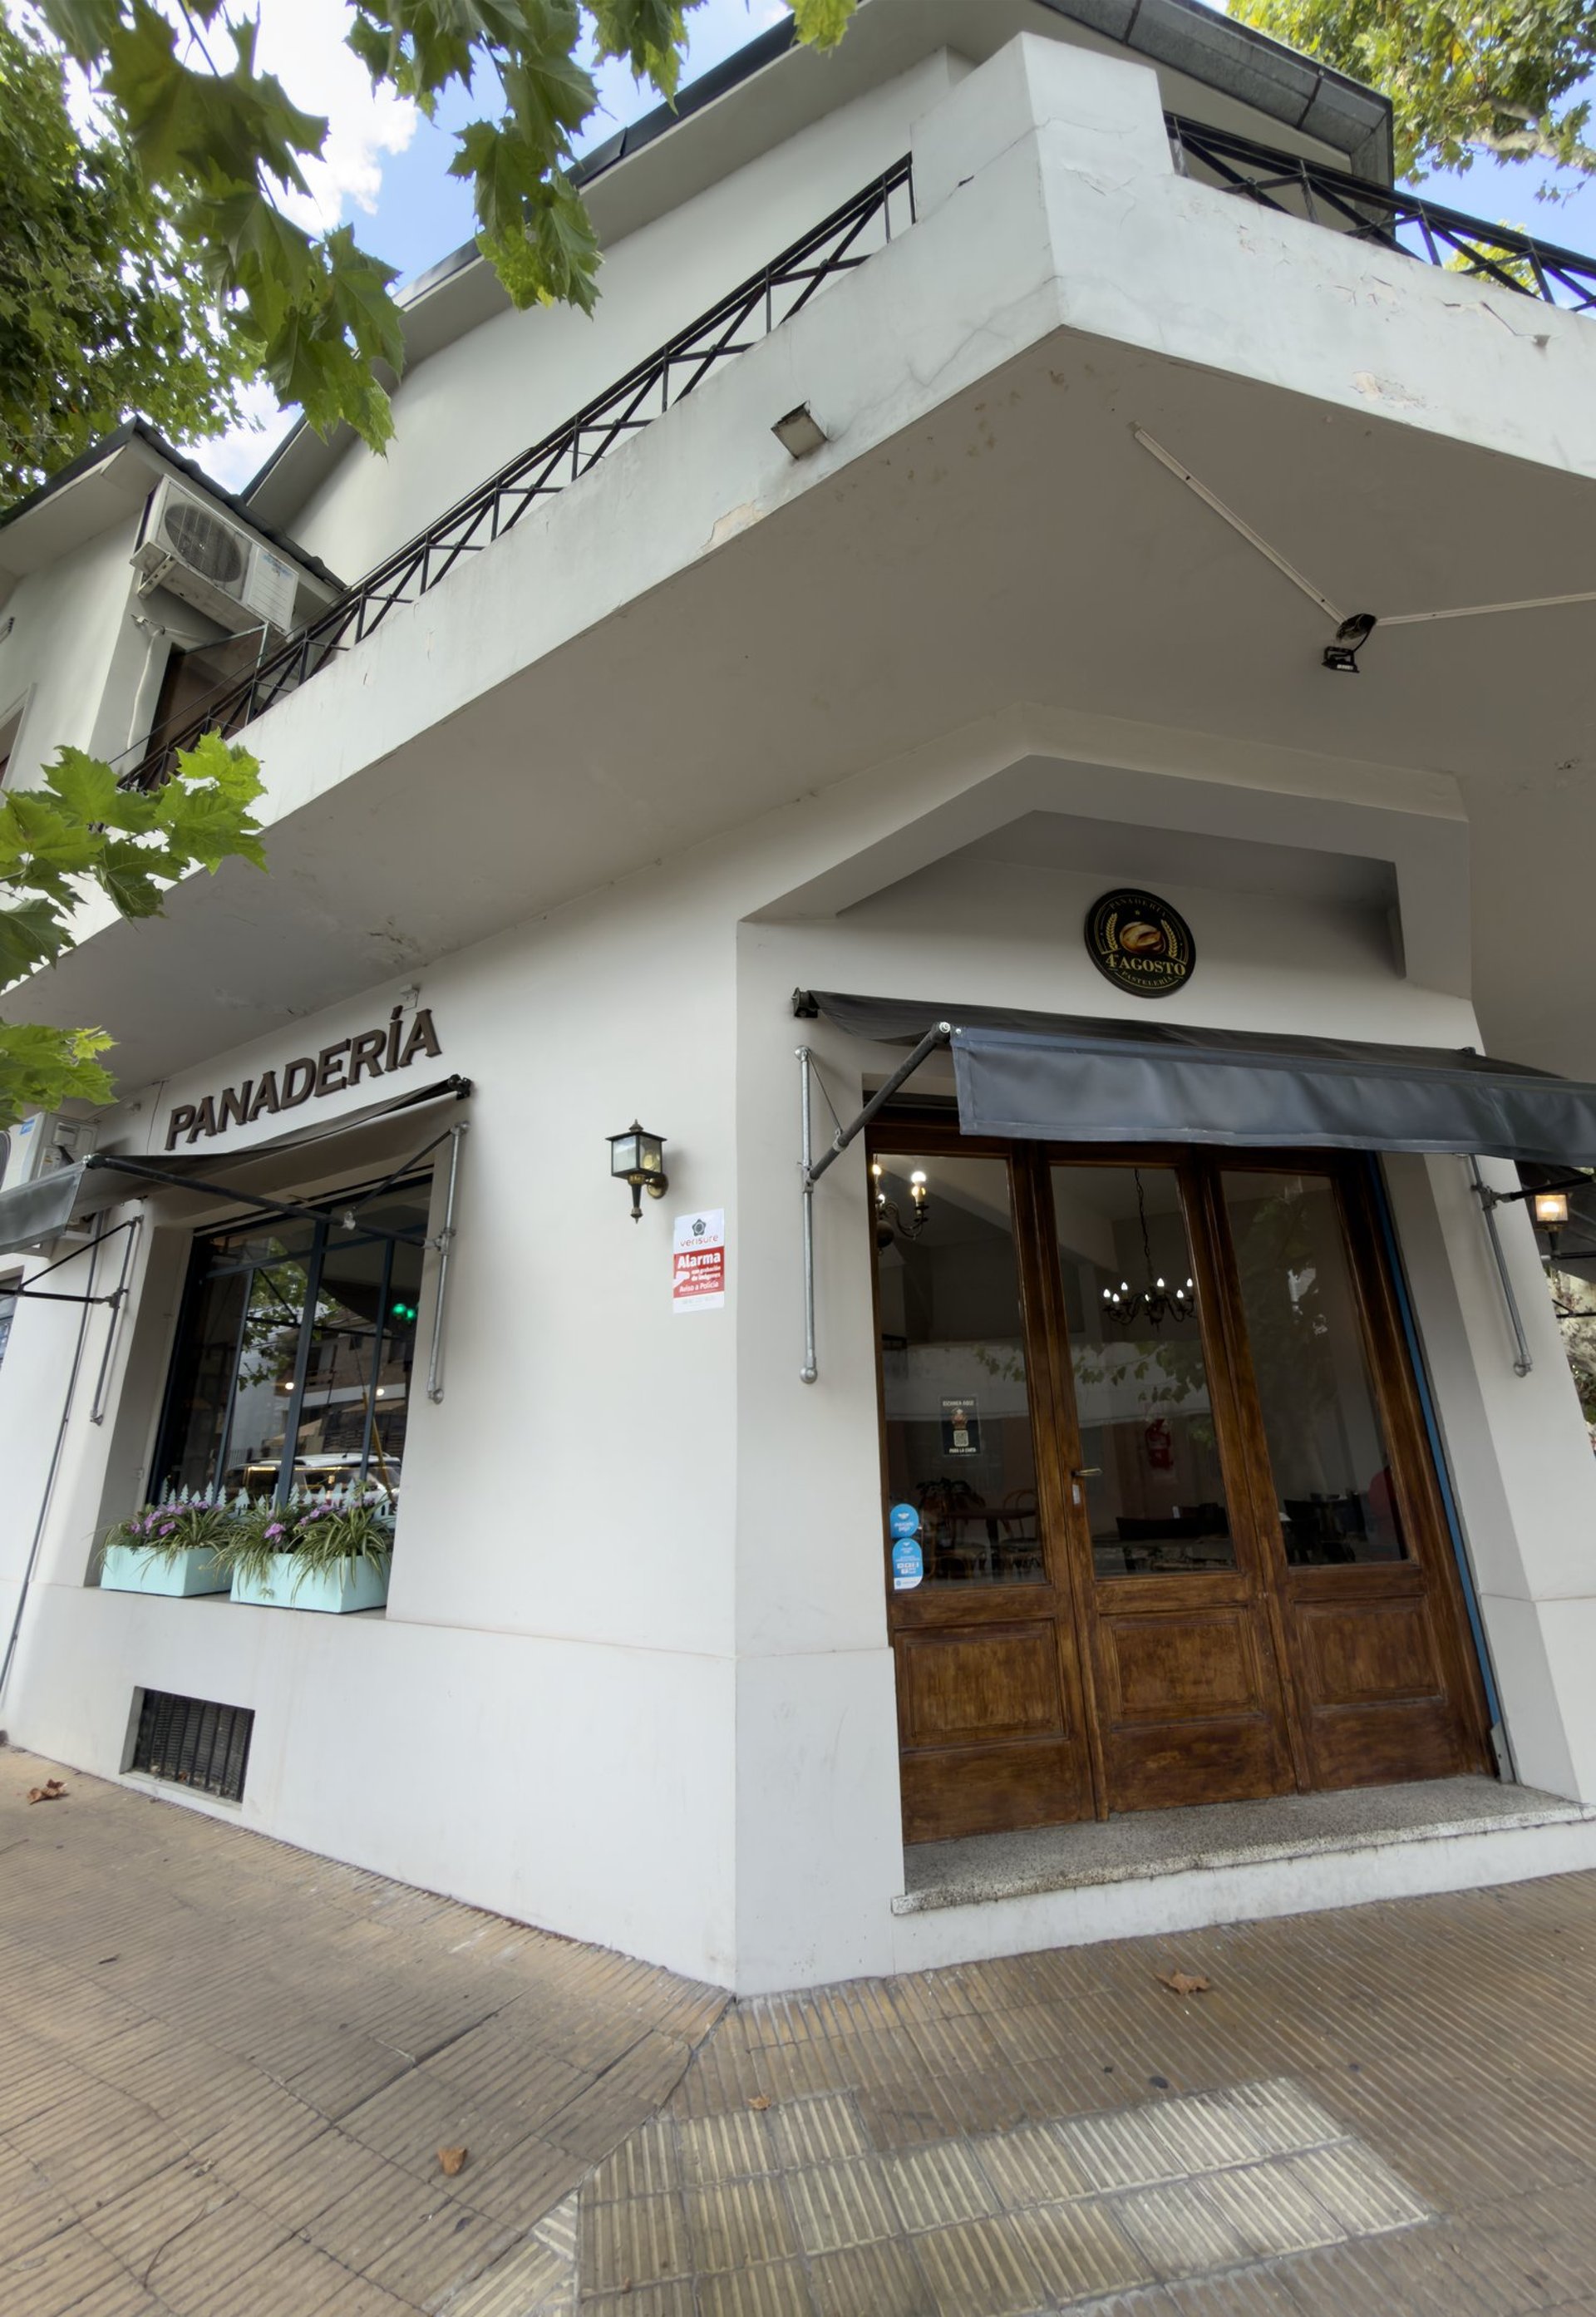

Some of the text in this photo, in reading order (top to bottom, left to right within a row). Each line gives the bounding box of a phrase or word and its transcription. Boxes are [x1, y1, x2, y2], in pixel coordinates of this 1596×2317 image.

[1106, 954, 1186, 976] 4 AGOSTO
[165, 1004, 441, 1151] PANADERÍA
[680, 1235, 719, 1247] verisure
[677, 1252, 721, 1269] Alarma
